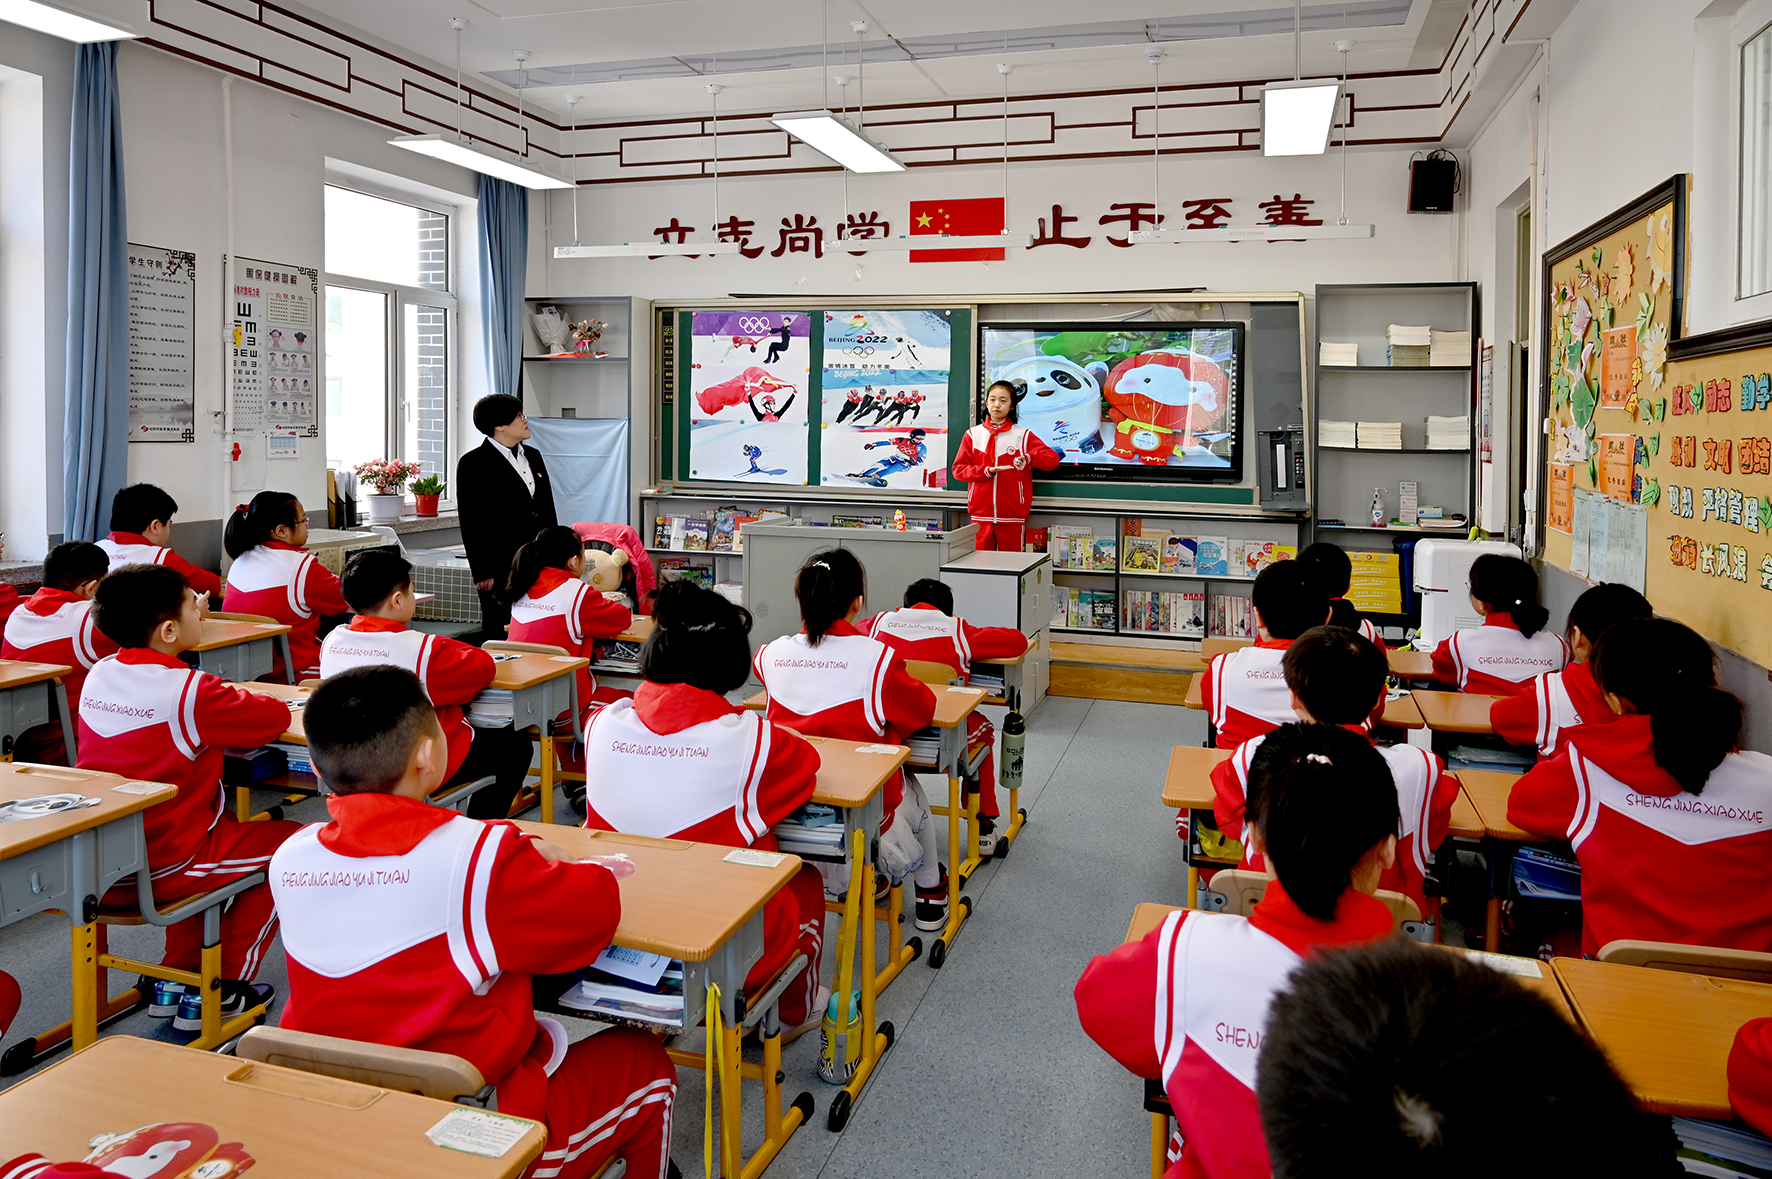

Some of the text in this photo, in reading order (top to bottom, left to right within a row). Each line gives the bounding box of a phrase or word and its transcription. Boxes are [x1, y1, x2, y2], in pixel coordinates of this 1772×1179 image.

[648, 193, 1324, 259] 立志尚学 止于至善
[128, 255, 164, 270] 学生守则
[245, 267, 298, 286] 眼保健操图解
[856, 335, 888, 344] 2022
[833, 368, 882, 379] BEIJING 2022
[1702, 436, 1733, 475] 文明
[1702, 486, 1760, 534] 严格管理
